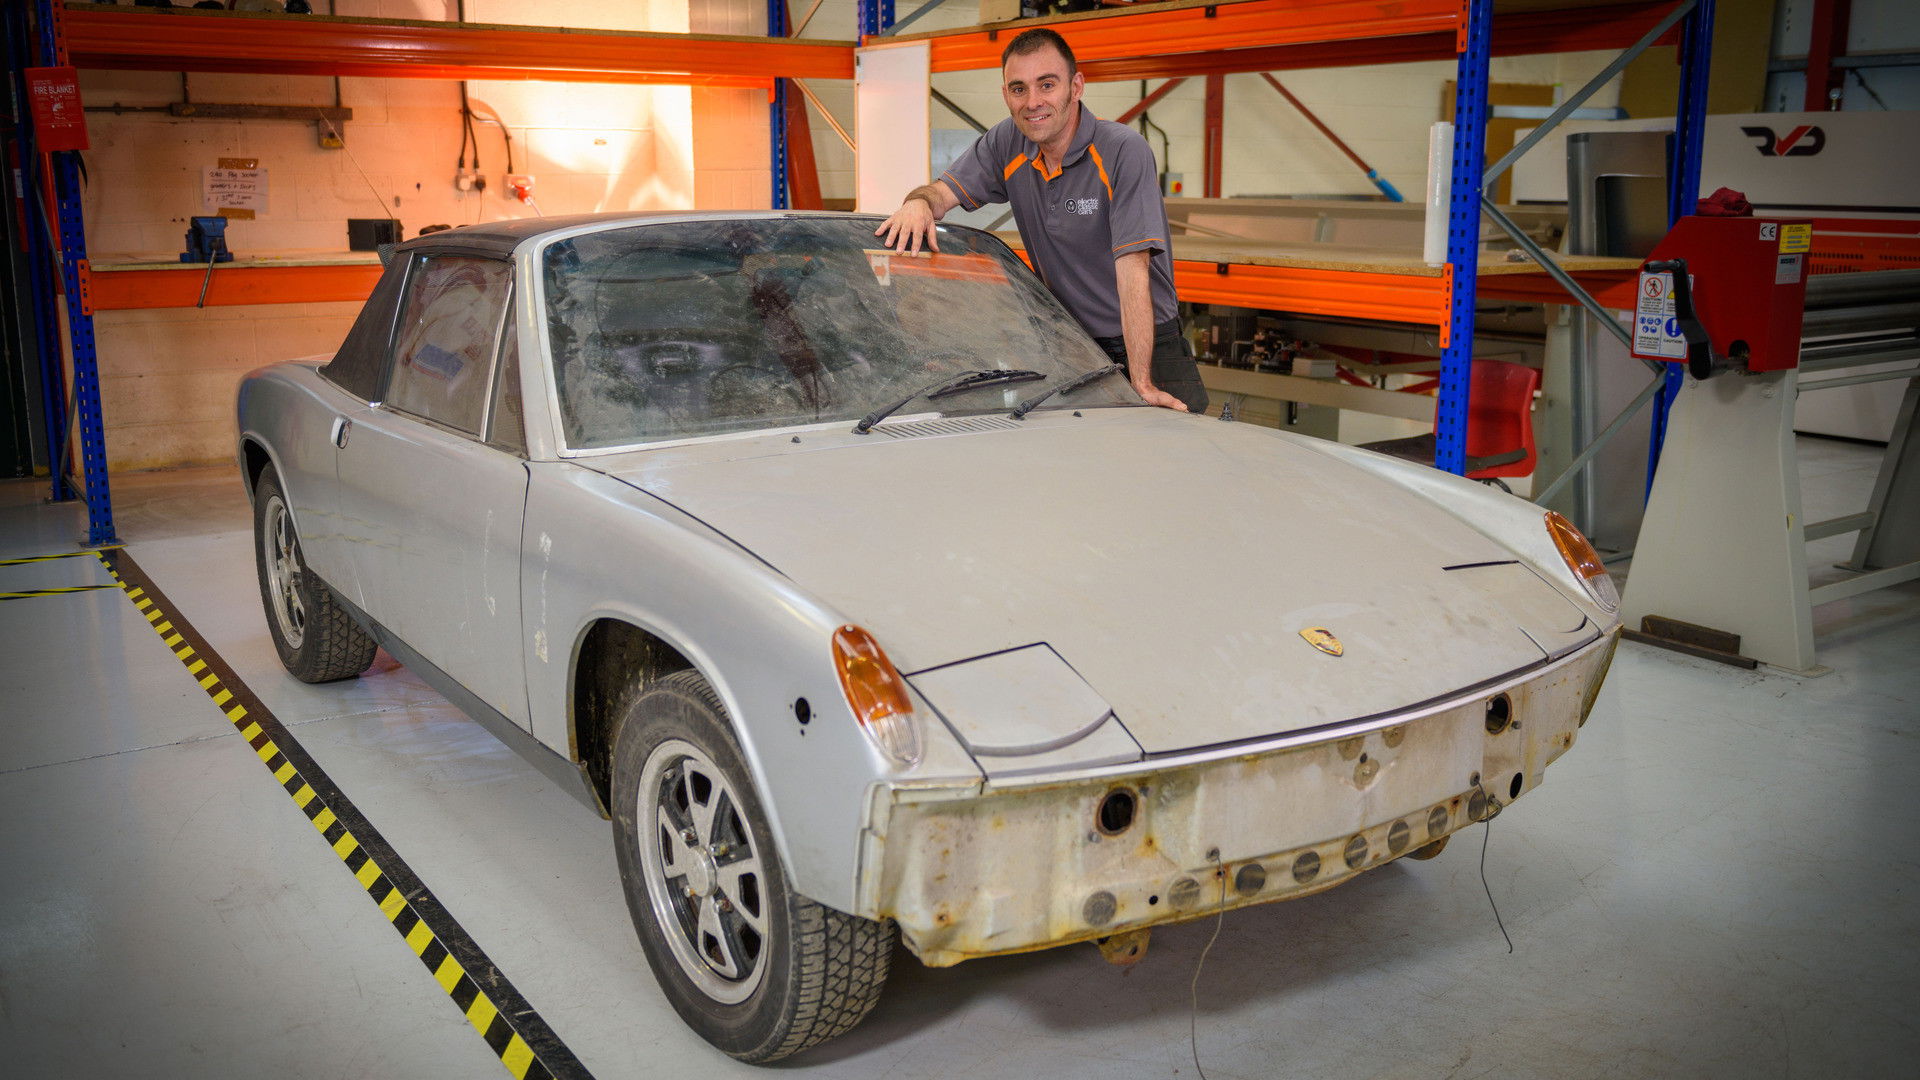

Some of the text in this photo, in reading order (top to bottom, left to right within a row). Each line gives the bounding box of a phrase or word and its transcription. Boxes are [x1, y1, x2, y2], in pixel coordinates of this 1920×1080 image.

[34, 84, 76, 94] FIRE BLANKET
[1760, 226, 1776, 238] CE
